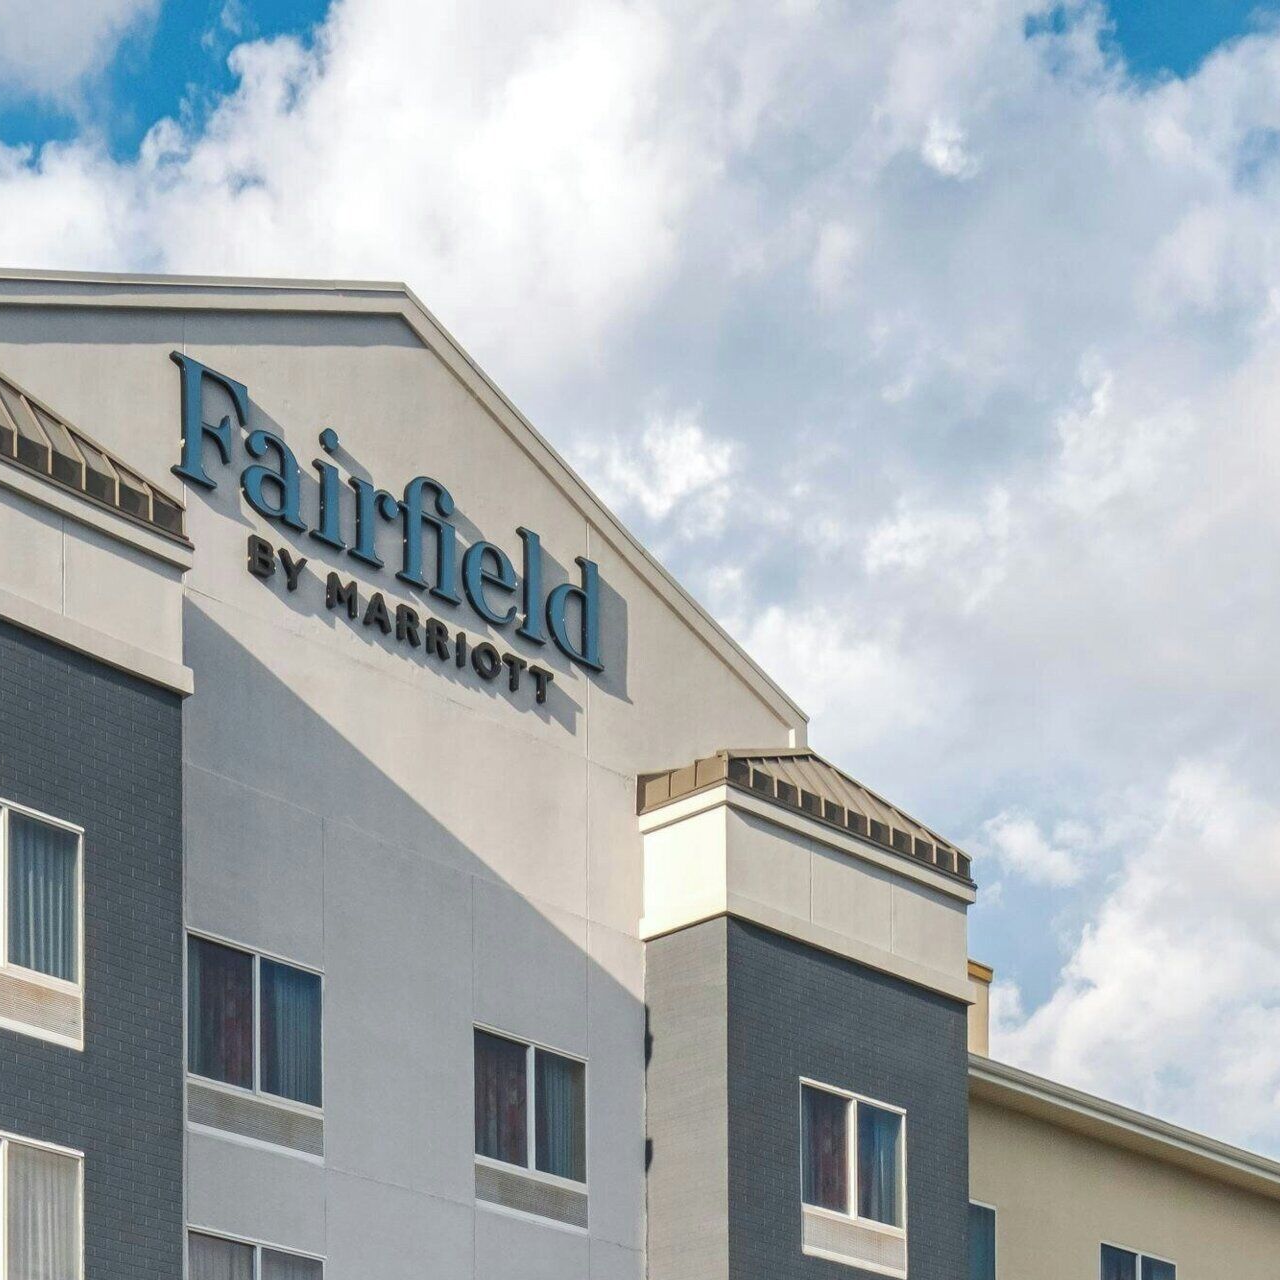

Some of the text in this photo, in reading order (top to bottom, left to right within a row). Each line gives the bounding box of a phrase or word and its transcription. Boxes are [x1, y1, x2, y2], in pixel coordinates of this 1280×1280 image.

[169, 350, 604, 672] Fairfield
[247, 534, 554, 704] BY MARRIOTT
